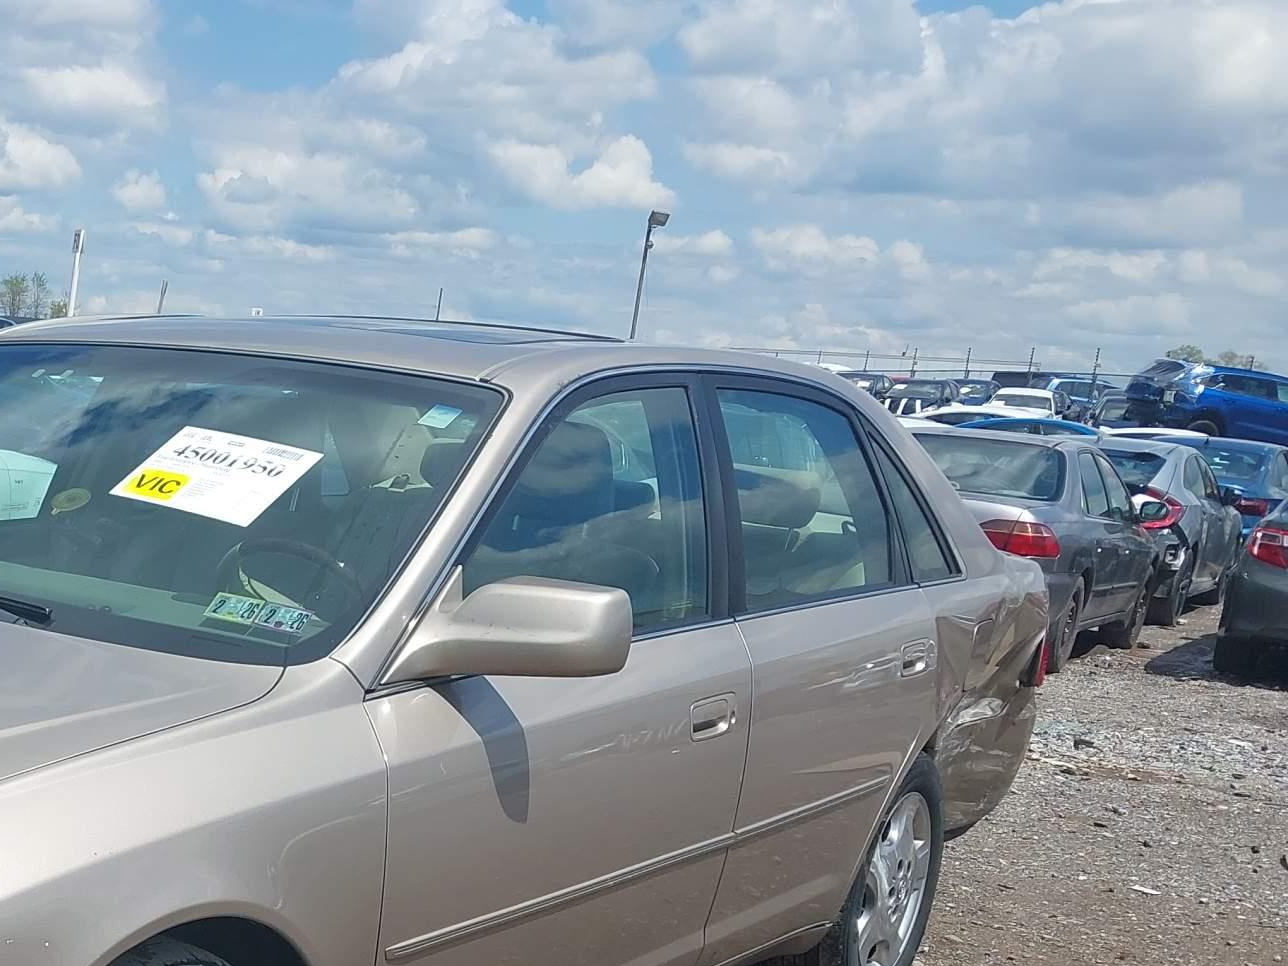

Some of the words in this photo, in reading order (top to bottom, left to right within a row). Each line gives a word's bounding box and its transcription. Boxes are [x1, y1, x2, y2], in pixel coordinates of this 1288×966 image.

[173, 444, 286, 478] 45001950
[136, 473, 181, 494] VIC
[213, 599, 226, 614] 2
[264, 608, 277, 624] 2
